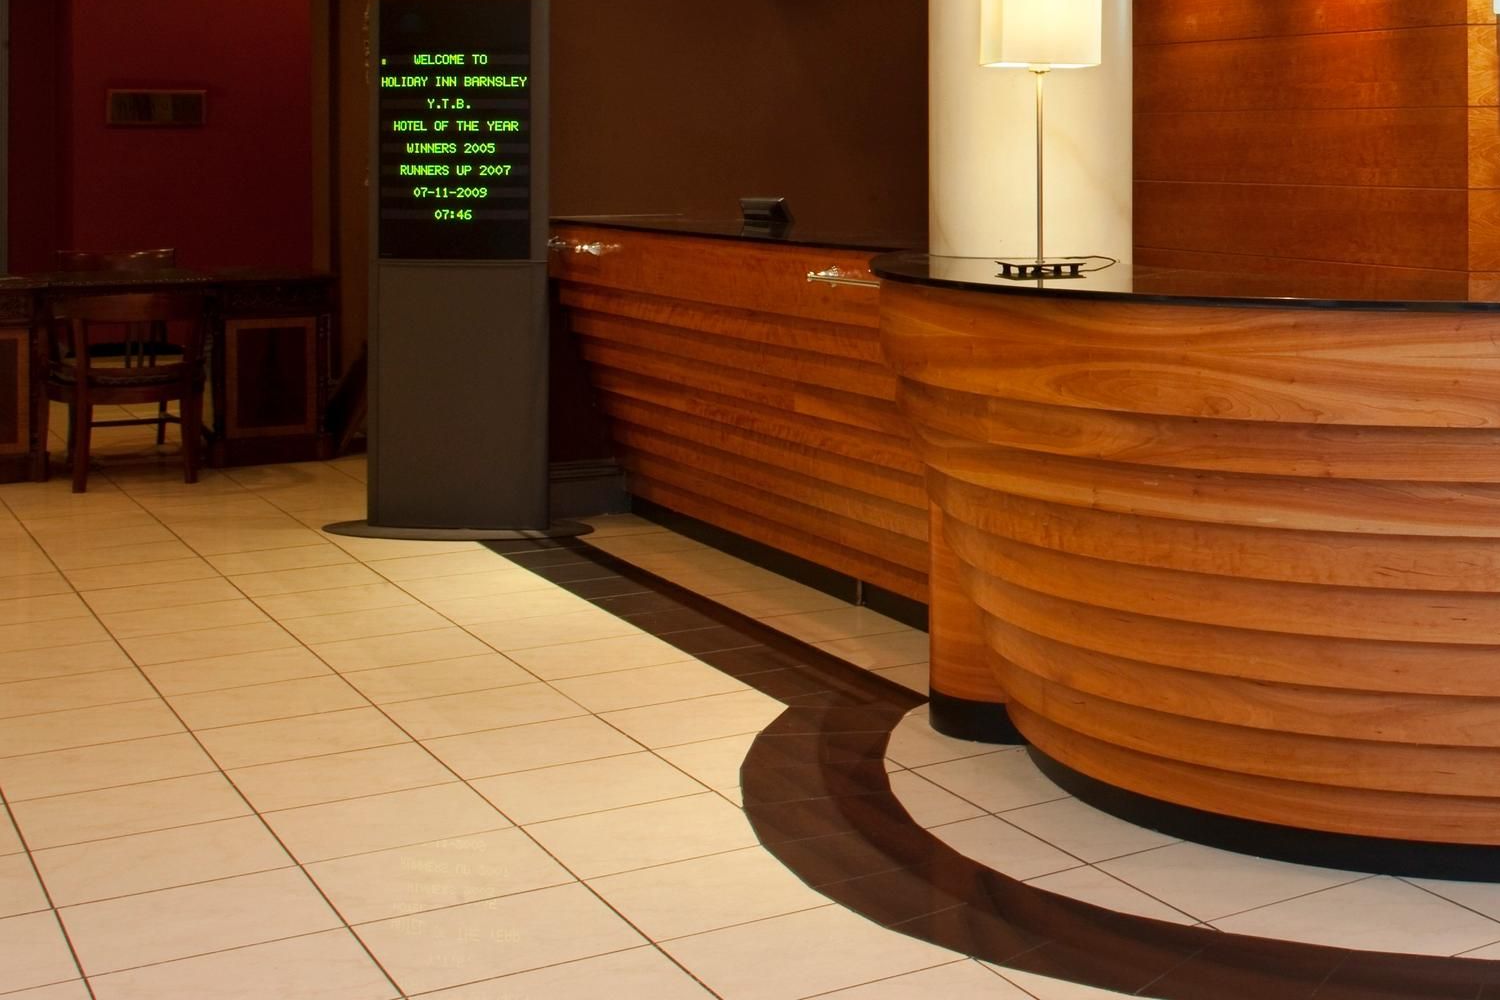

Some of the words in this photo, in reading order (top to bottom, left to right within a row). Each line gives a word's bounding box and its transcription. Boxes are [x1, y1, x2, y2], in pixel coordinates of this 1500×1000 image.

[414, 54, 464, 65] WELCOME
[472, 54, 487, 65] TO
[381, 76, 428, 87] HOLIDAY
[435, 76, 456, 87] INN
[463, 76, 527, 87] BARNSLEY
[427, 98, 471, 109] Y.T.B.
[393, 121, 427, 131] HOTEL
[434, 121, 449, 131] OF
[456, 121, 479, 131] THE
[487, 121, 518, 131] YEAR
[407, 143, 456, 153] WINNERS
[464, 143, 495, 153] 2005
[400, 165, 449, 175] RUNNERS
[456, 165, 472, 175] UP
[479, 165, 511, 175] 2007
[413, 187, 487, 198] 07-11-2009
[434, 209, 472, 220] 07:46
